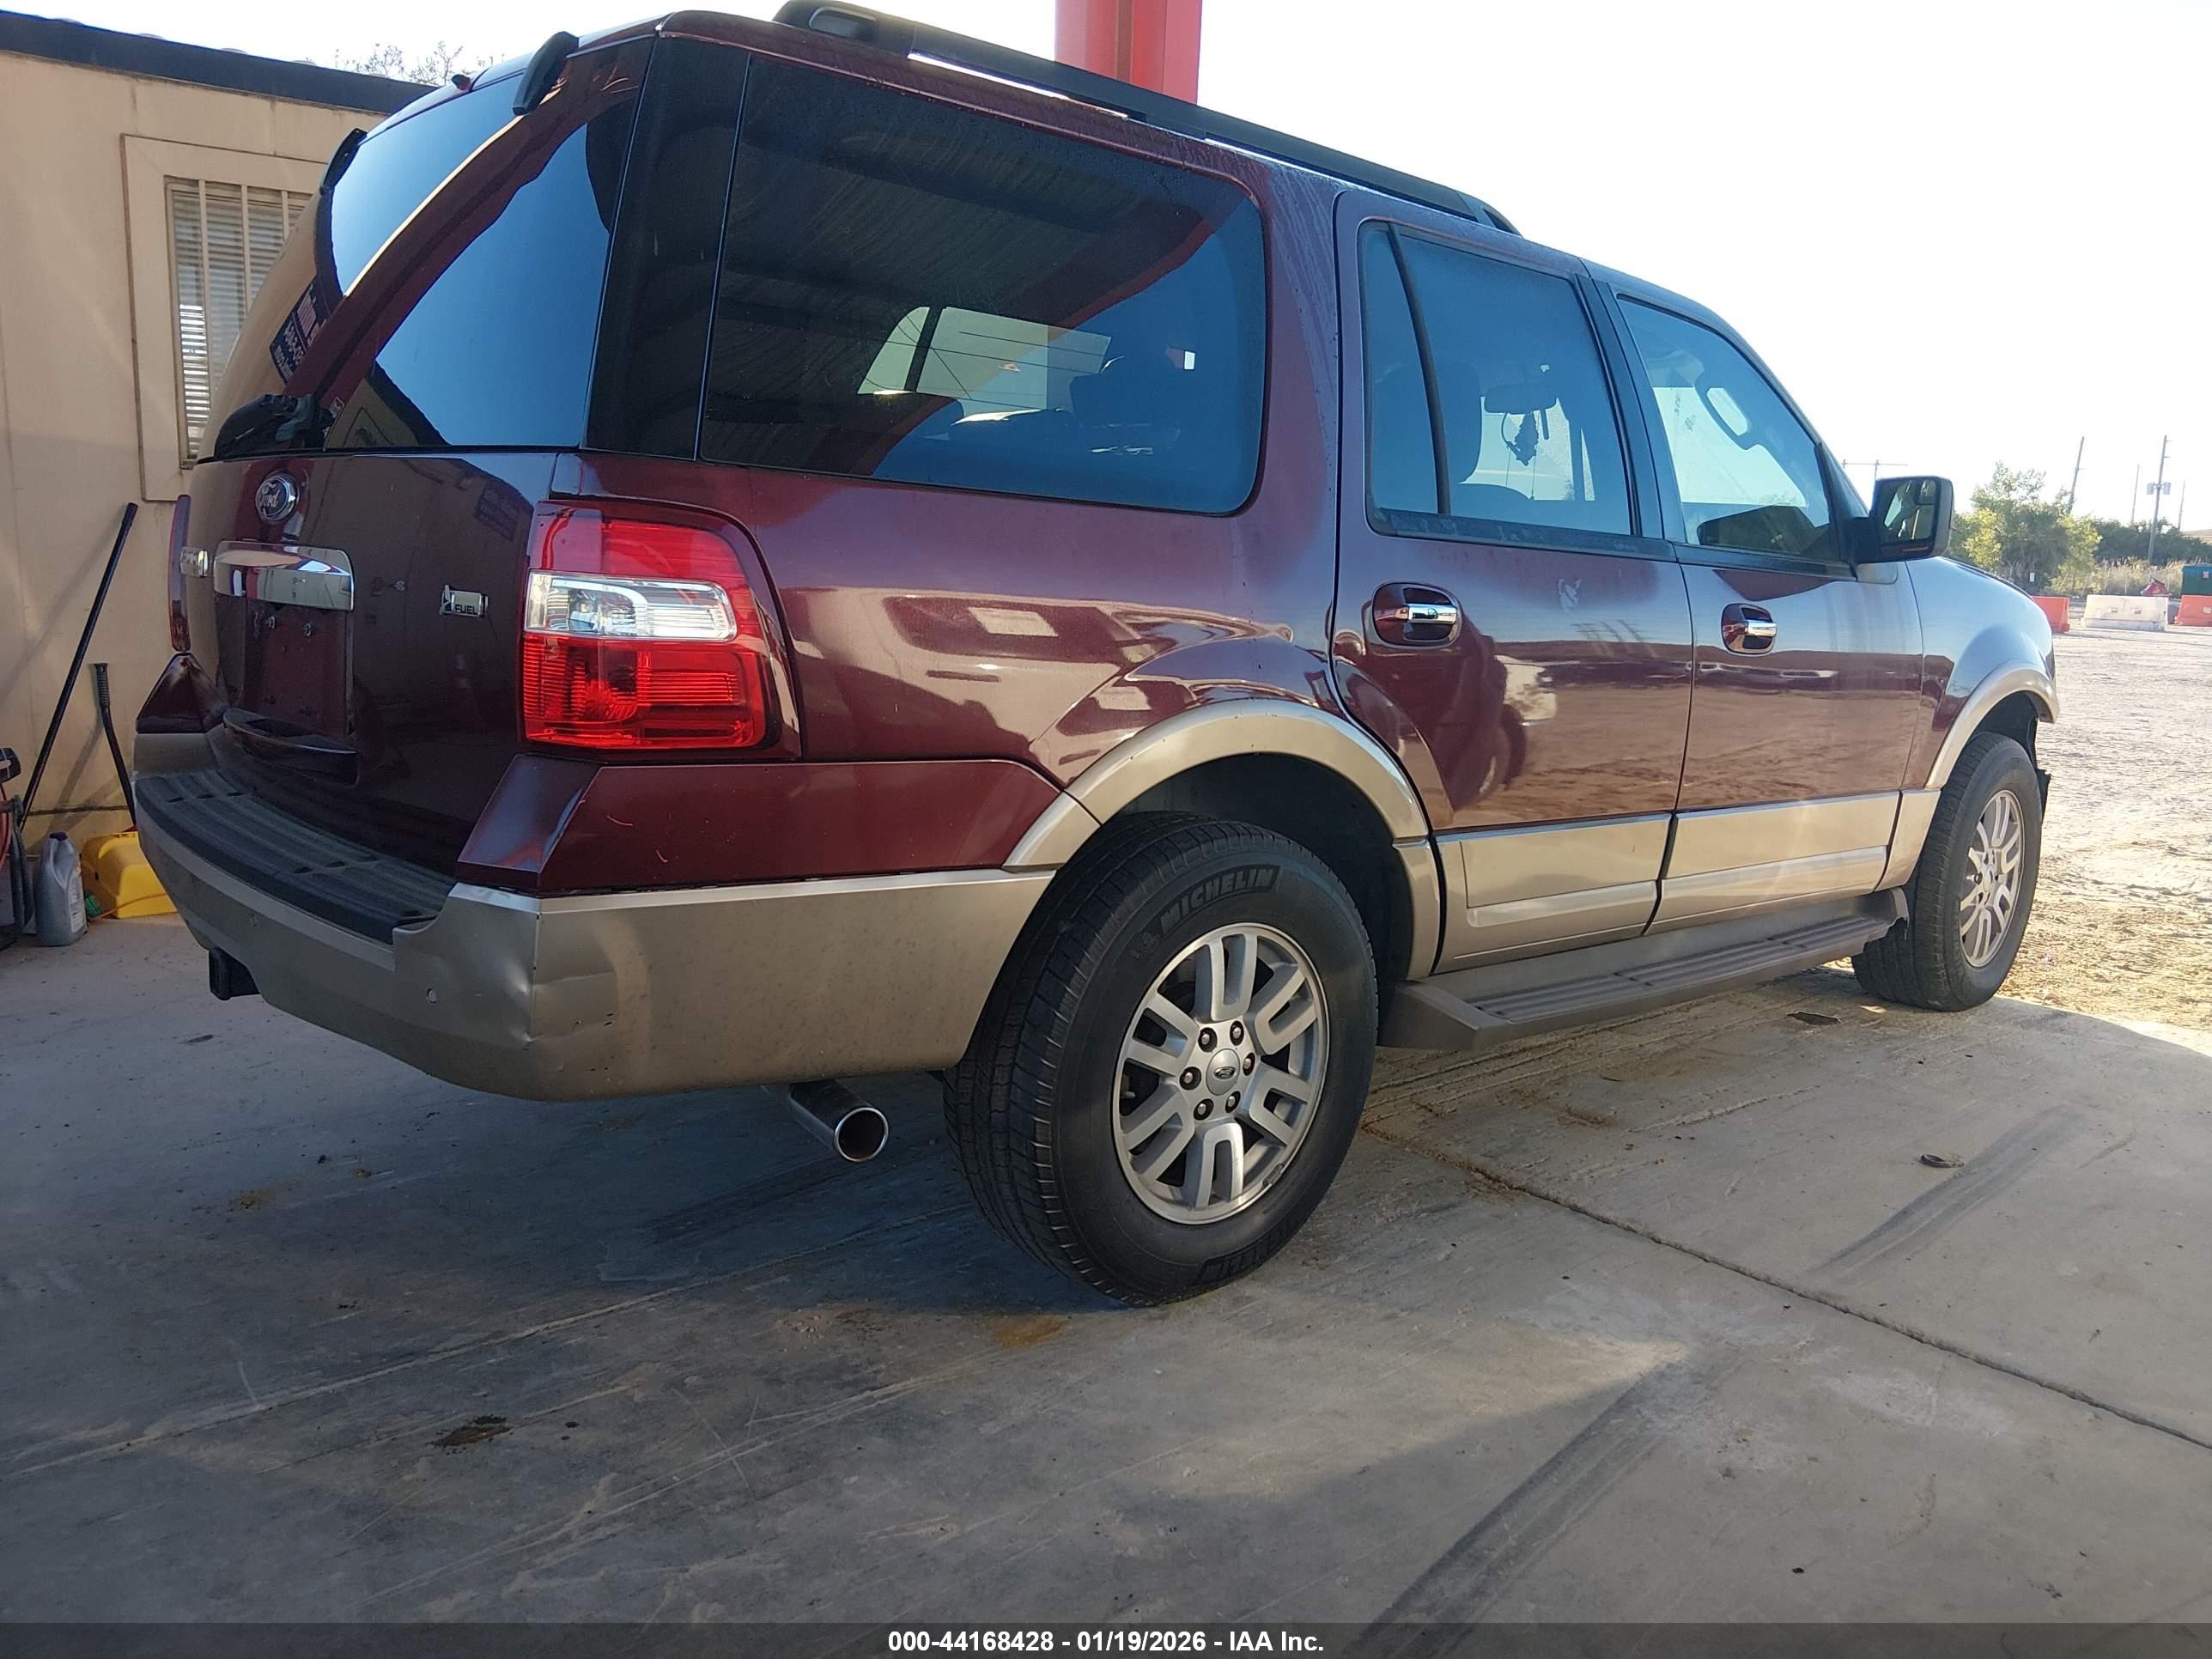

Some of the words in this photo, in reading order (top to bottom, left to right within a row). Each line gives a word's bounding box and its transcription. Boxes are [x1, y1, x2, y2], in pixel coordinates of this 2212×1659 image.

[258, 482, 281, 509] Ford
[454, 604, 478, 616] FUEL
[1160, 867, 1275, 934] MICHELIN
